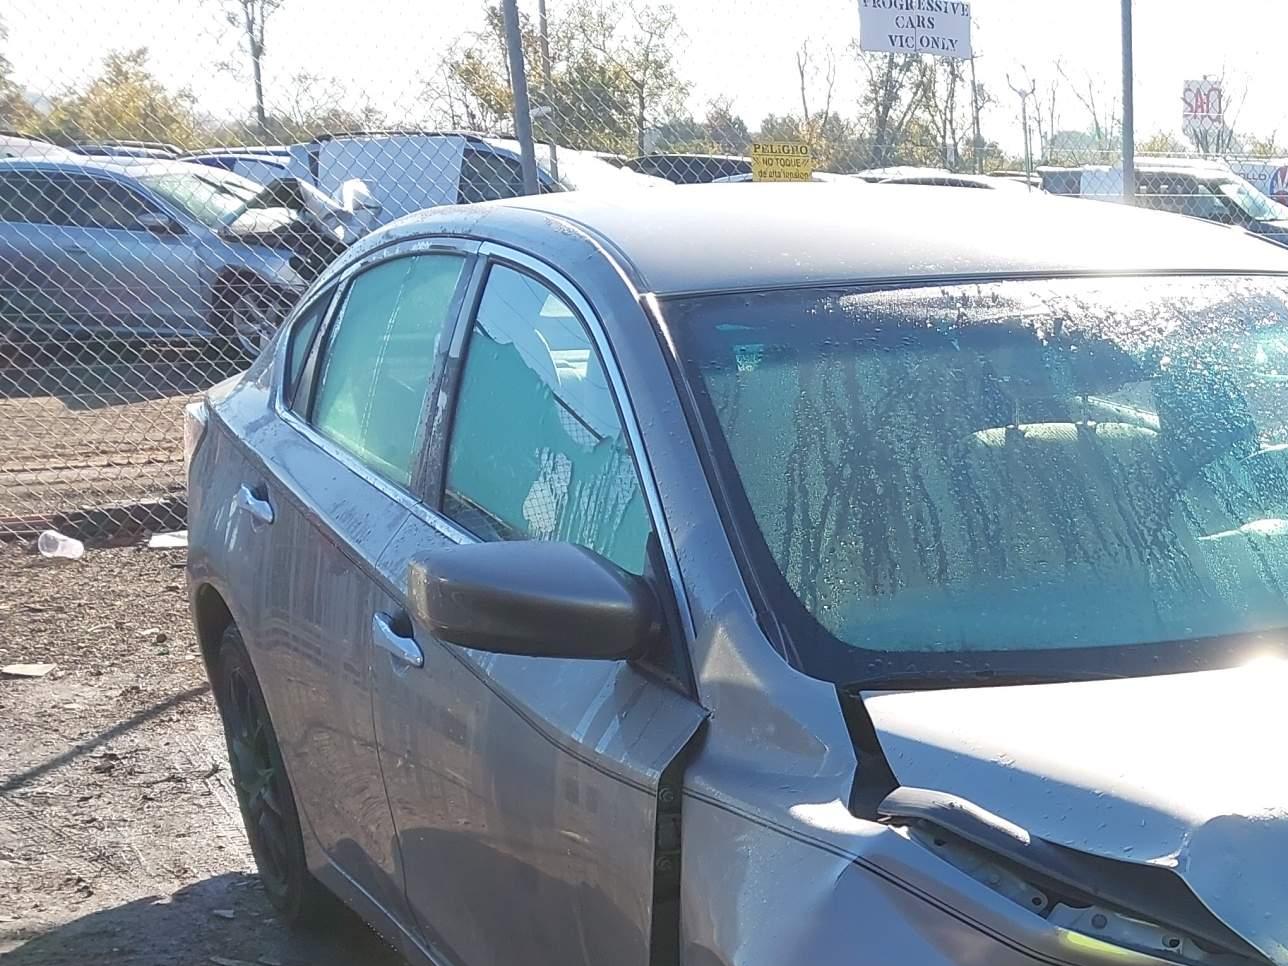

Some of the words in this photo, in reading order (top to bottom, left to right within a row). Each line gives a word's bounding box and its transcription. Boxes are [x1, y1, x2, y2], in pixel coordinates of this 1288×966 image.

[863, 0, 969, 17] PROGRESSIVE
[895, 14, 935, 29] CARS
[888, 34, 914, 49] VIC
[919, 35, 958, 52] ONLY
[762, 157, 774, 166] NO
[776, 157, 801, 167] TOQUE
